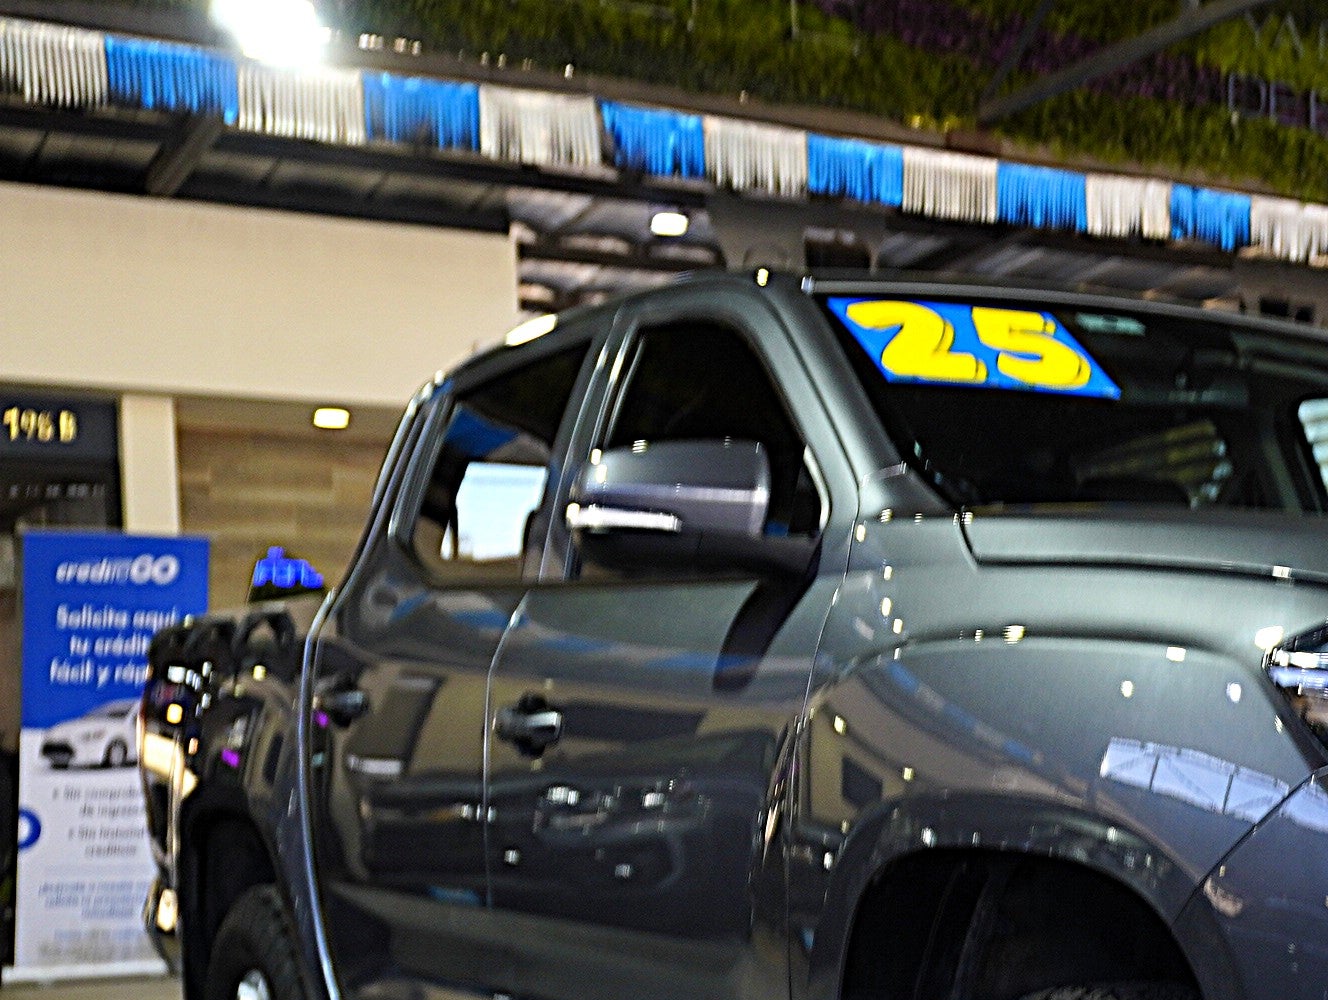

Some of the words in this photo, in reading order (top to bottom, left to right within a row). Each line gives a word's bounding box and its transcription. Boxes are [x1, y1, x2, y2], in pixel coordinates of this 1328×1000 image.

[1243, 10, 1306, 59] YA
[1227, 70, 1304, 129] DE
[846, 300, 1091, 390] 25
[69, 634, 90, 655] tu
[94, 632, 149, 656] crédit
[50, 657, 94, 684] fácil
[97, 664, 110, 689] y
[114, 658, 148, 688] ráp
